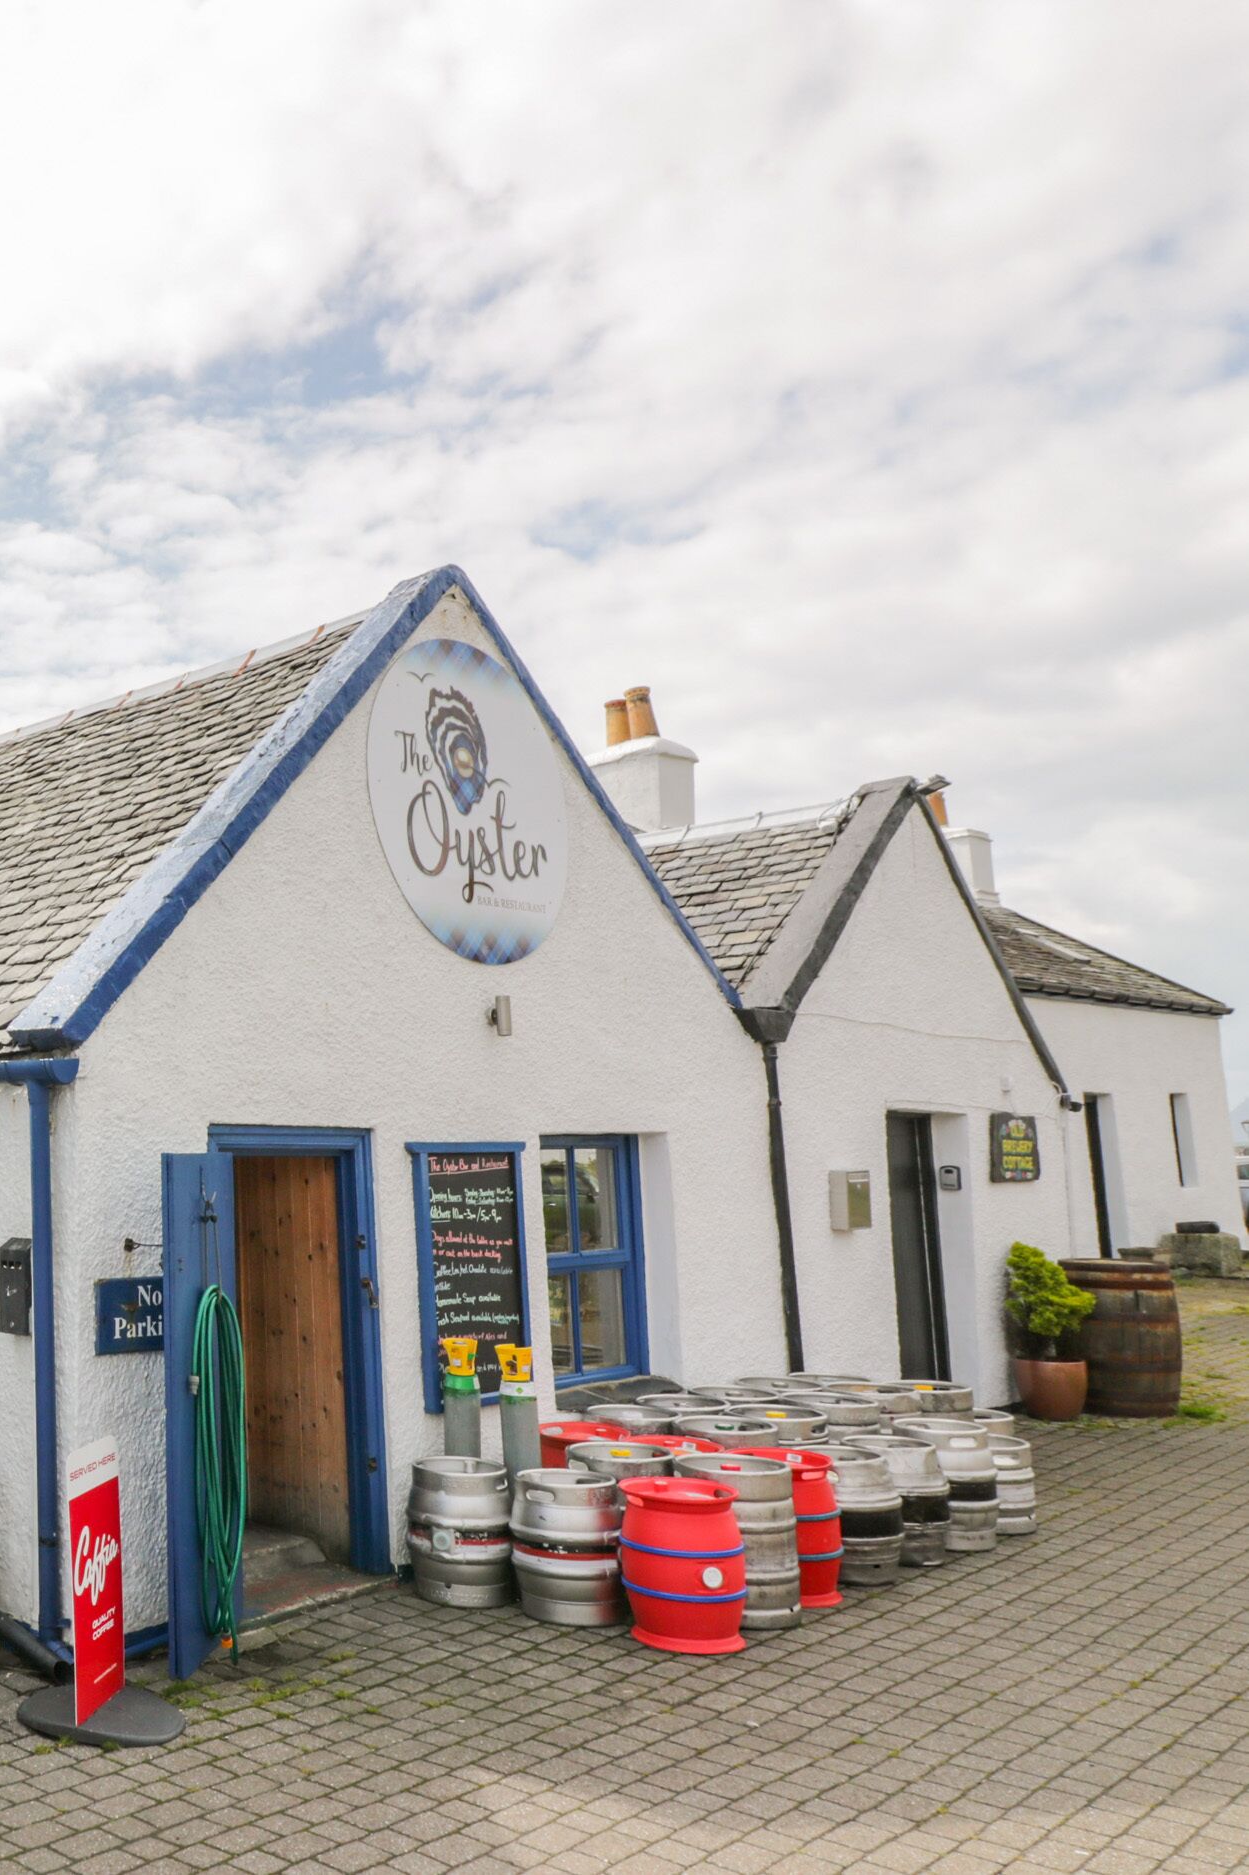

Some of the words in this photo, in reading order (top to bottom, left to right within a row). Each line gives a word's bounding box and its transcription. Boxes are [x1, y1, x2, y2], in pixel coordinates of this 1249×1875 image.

[394, 729, 433, 777] The
[406, 779, 548, 903] Oyster
[137, 1285, 163, 1306] No
[113, 1314, 163, 1340] Parki
[69, 1462, 97, 1482] SERVED
[97, 1452, 117, 1469] HERE
[91, 1605, 116, 1630] QUALITY
[92, 1618, 115, 1641] COFFEE
